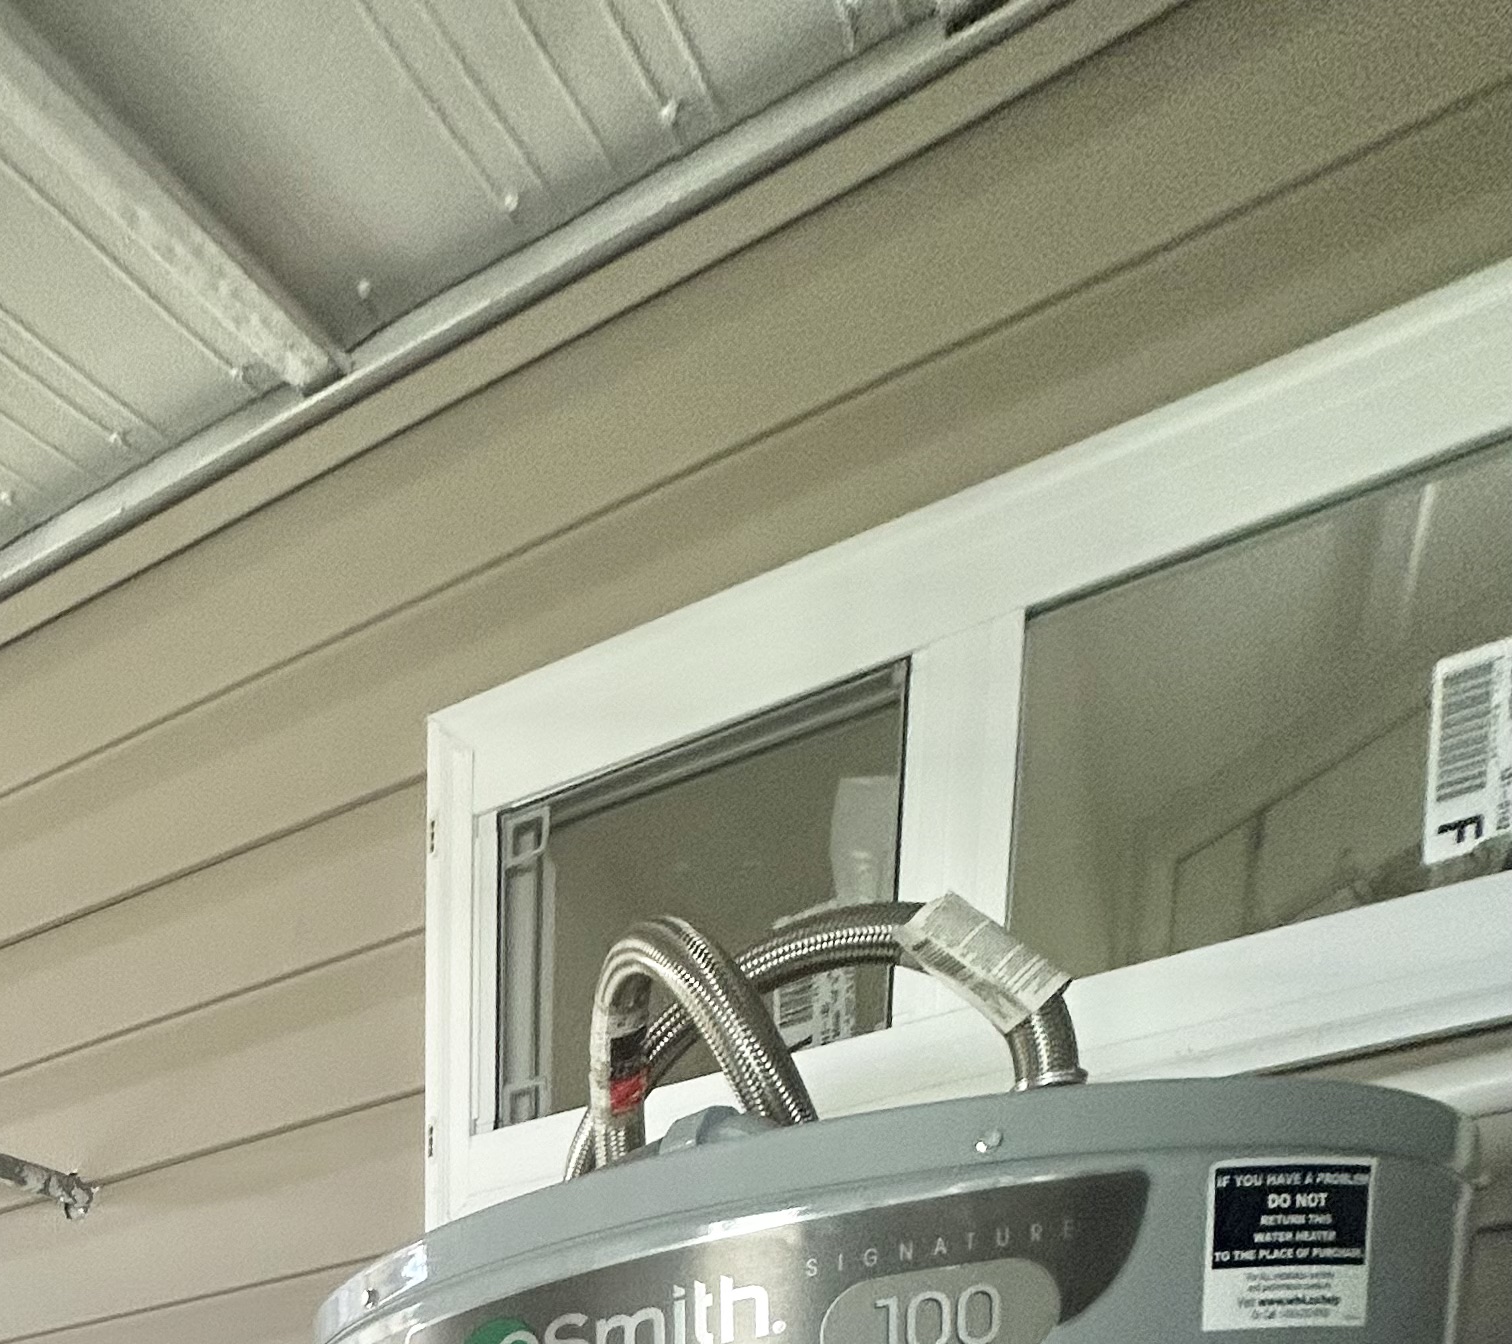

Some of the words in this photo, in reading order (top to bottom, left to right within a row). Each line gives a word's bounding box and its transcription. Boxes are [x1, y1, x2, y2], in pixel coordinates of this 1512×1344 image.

[1216, 1174, 1230, 1188] IF
[1233, 1174, 1263, 1188] YOU
[1266, 1172, 1302, 1186] HAVE
[1304, 1172, 1313, 1185] A
[1267, 1193, 1292, 1209] DO
[1295, 1192, 1329, 1208] NOT
[1259, 1214, 1306, 1226] RETURN
[1253, 1231, 1293, 1243] WATER
[1295, 1230, 1337, 1242] HEATER
[805, 1219, 1074, 1277] SIGNATURE
[1214, 1251, 1230, 1262] TO
[1233, 1250, 1256, 1261] THE
[1258, 1248, 1294, 1260] PLACE
[1295, 1248, 1310, 1259] OF
